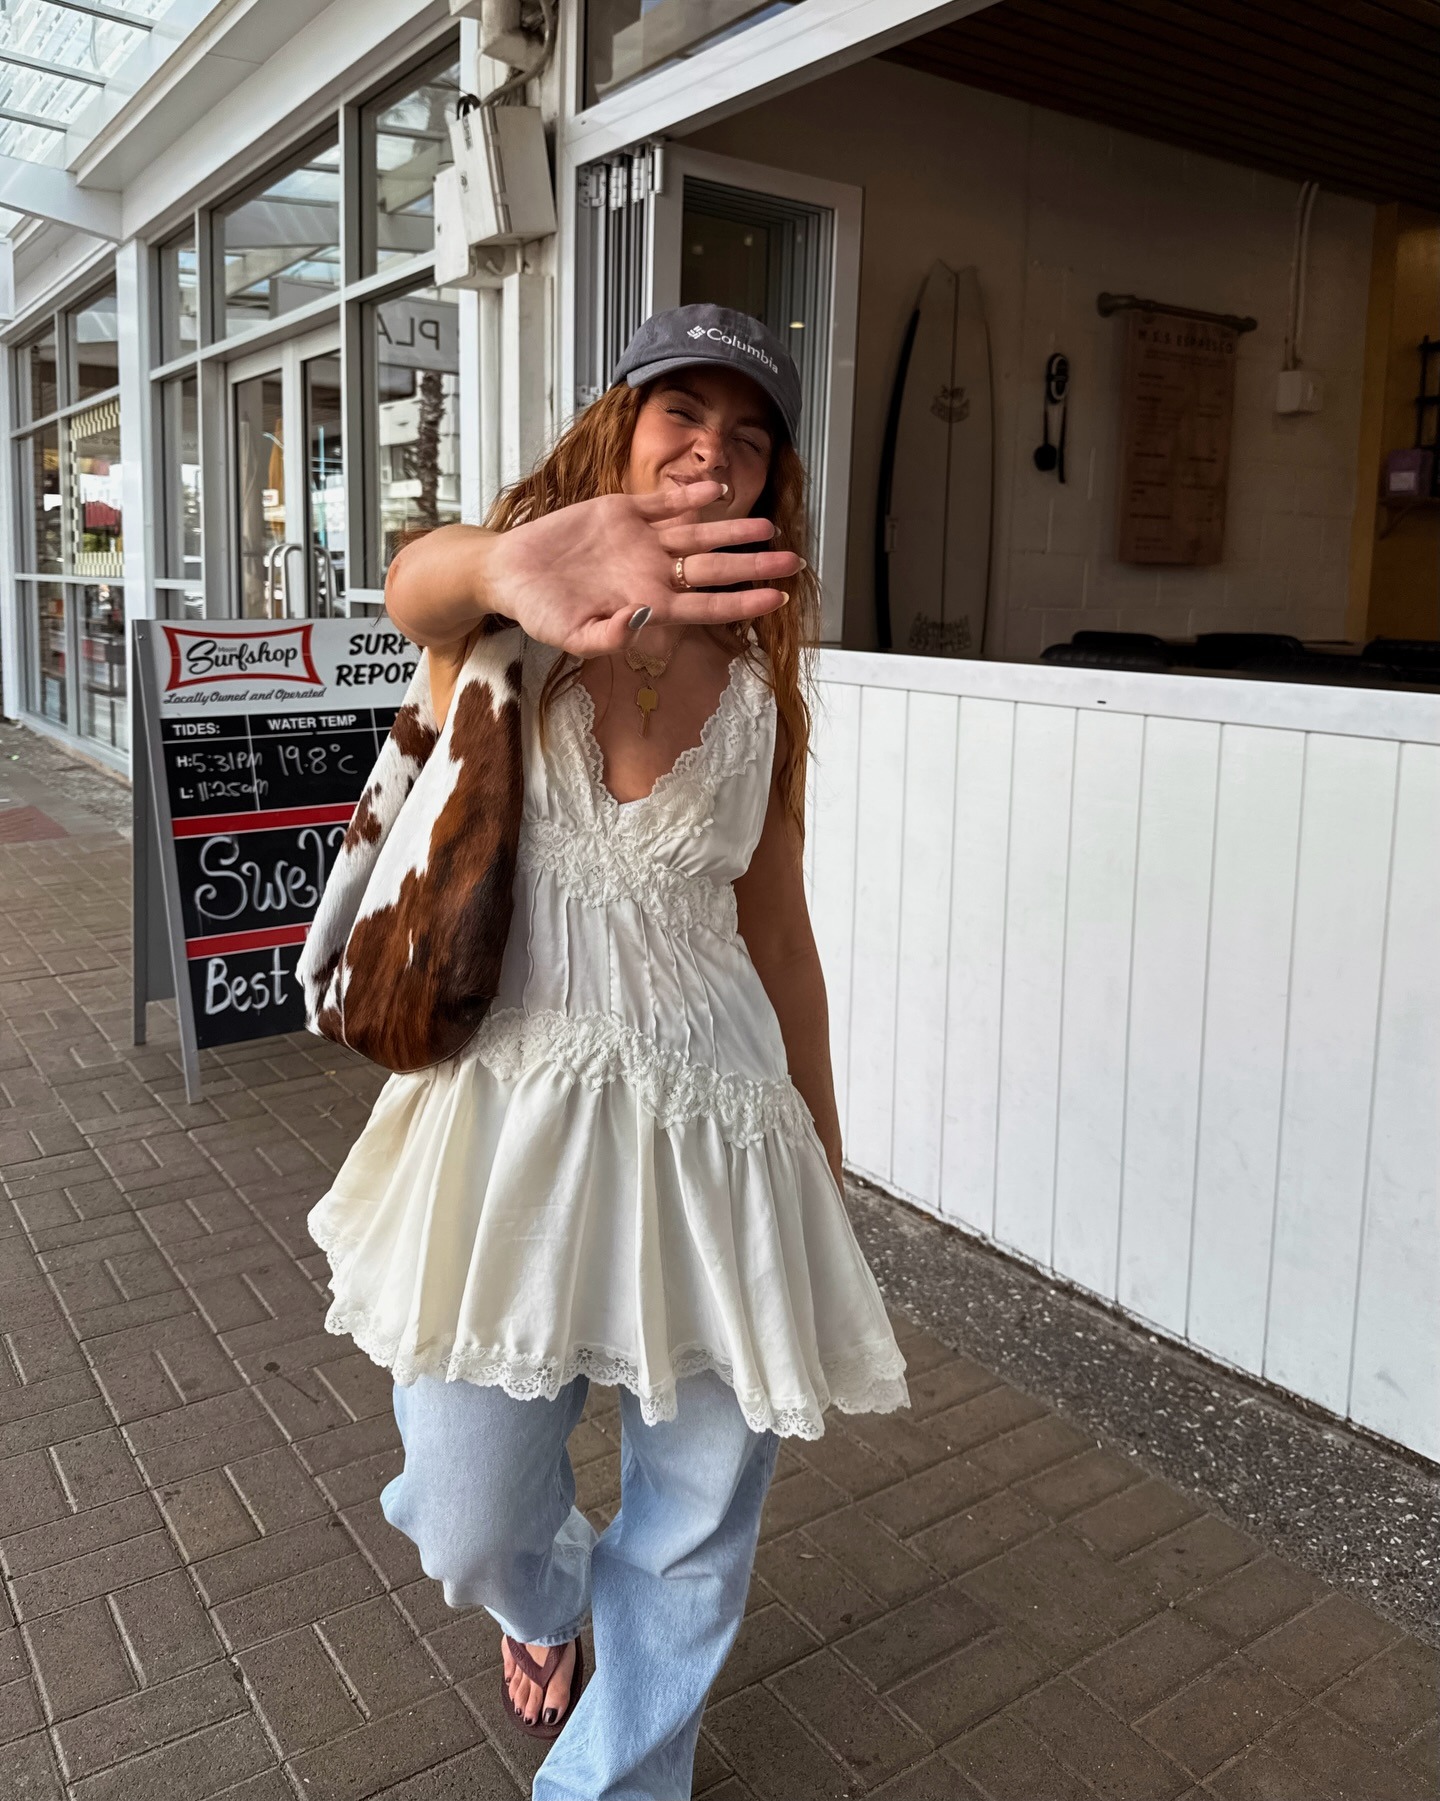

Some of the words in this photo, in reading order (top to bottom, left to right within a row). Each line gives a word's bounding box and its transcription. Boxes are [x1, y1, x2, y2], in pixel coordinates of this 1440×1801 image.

[706, 327, 779, 375] Columbia
[186, 639, 298, 675] Surfshop
[348, 633, 411, 656] SURF
[163, 691, 210, 706] Locally
[209, 690, 249, 703] Owned
[249, 689, 276, 701] and
[275, 687, 326, 703] Operated
[172, 722, 221, 737] TIDES:
[267, 717, 317, 731] WATER
[319, 715, 357, 728] TEMP
[194, 827, 346, 920] Swel
[204, 947, 290, 1015] Best
